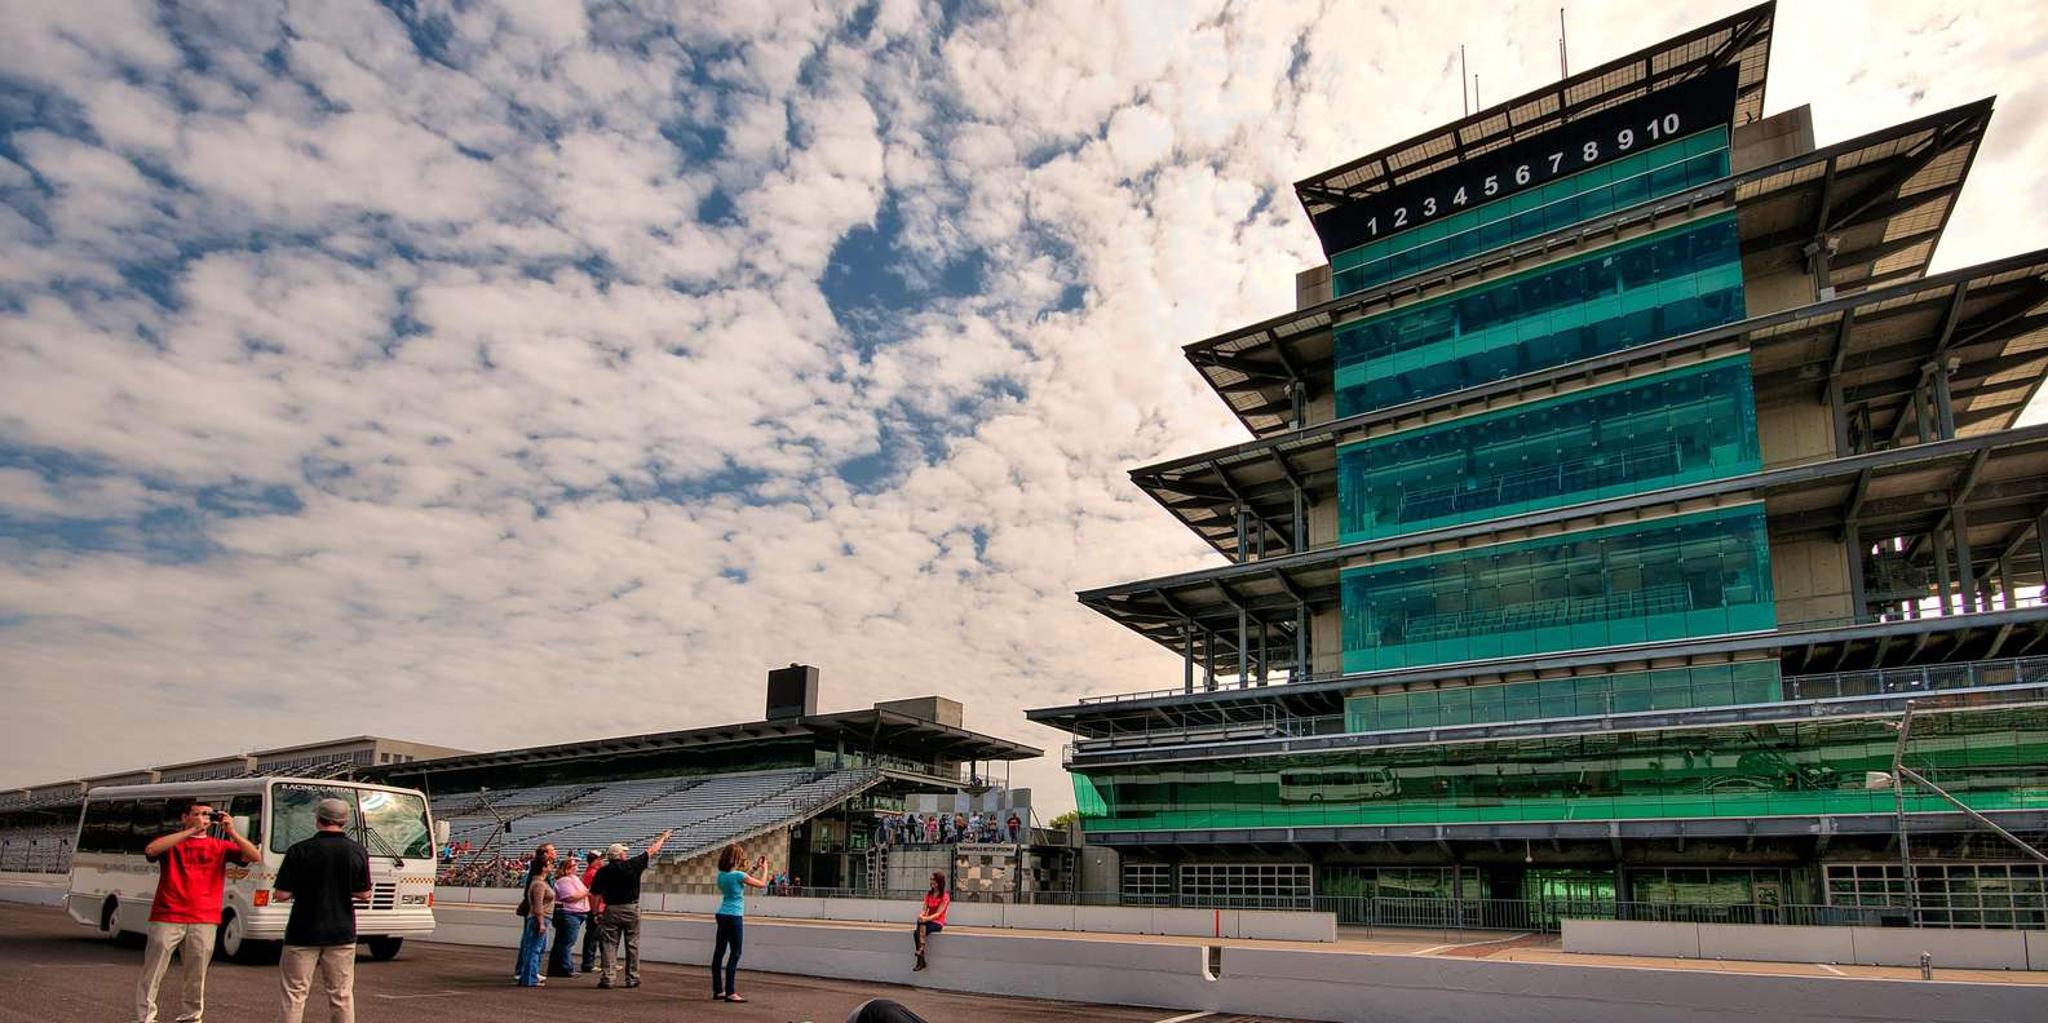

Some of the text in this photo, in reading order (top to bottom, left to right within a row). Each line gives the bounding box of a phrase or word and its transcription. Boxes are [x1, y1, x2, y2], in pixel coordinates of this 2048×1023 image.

[1367, 113, 1680, 235] 1 2 3 4 5 6 7 8 9 10
[281, 784, 317, 792] RACING
